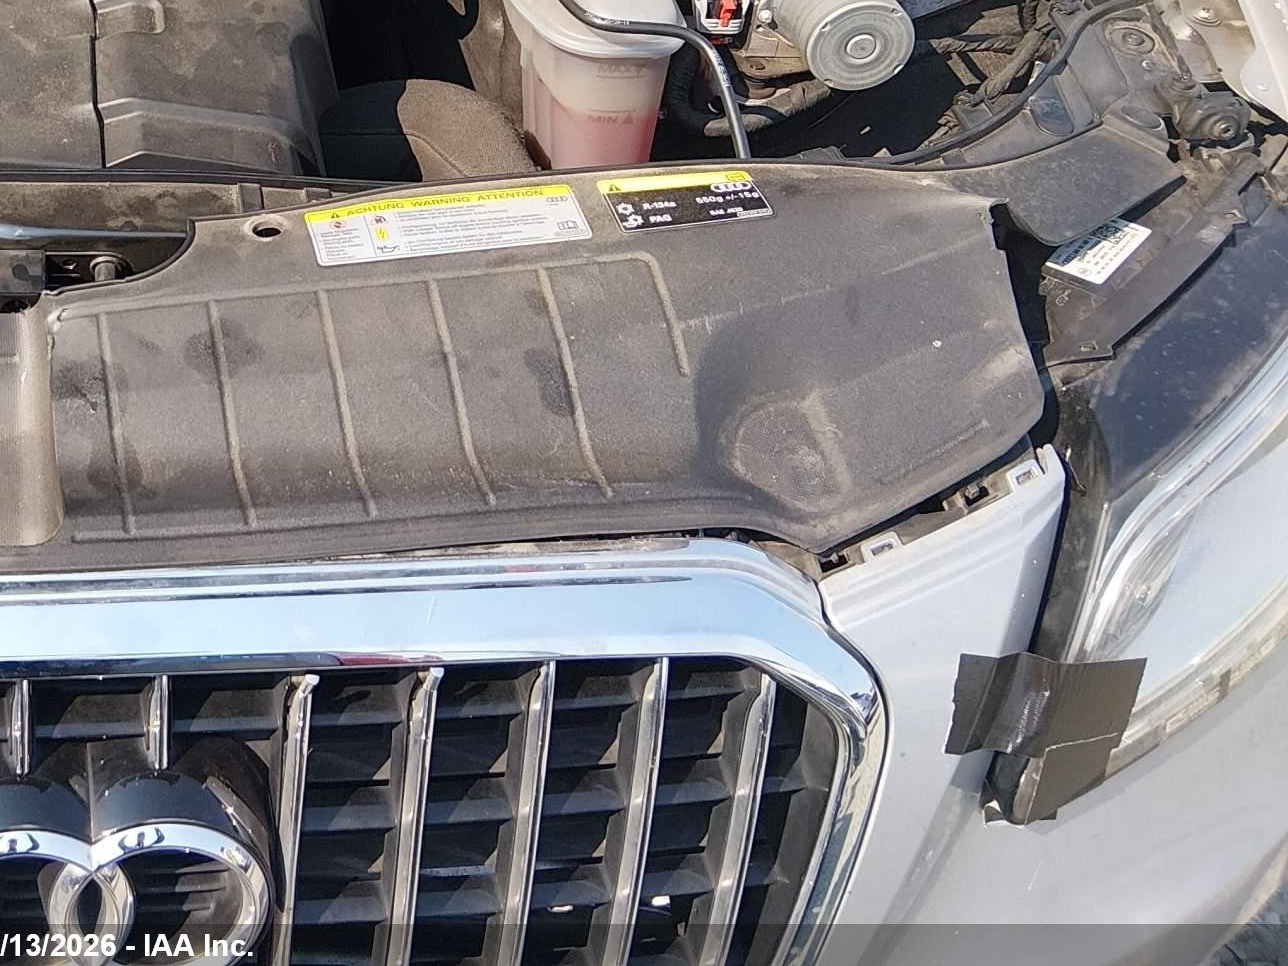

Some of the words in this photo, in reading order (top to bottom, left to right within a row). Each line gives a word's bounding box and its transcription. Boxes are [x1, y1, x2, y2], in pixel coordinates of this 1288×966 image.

[598, 64, 633, 75] MAX
[586, 114, 618, 124] MIN
[346, 202, 405, 217] ACHTUNG
[410, 196, 470, 208] WARNING
[477, 189, 544, 202] ATTENTION
[648, 214, 673, 223] PAG
